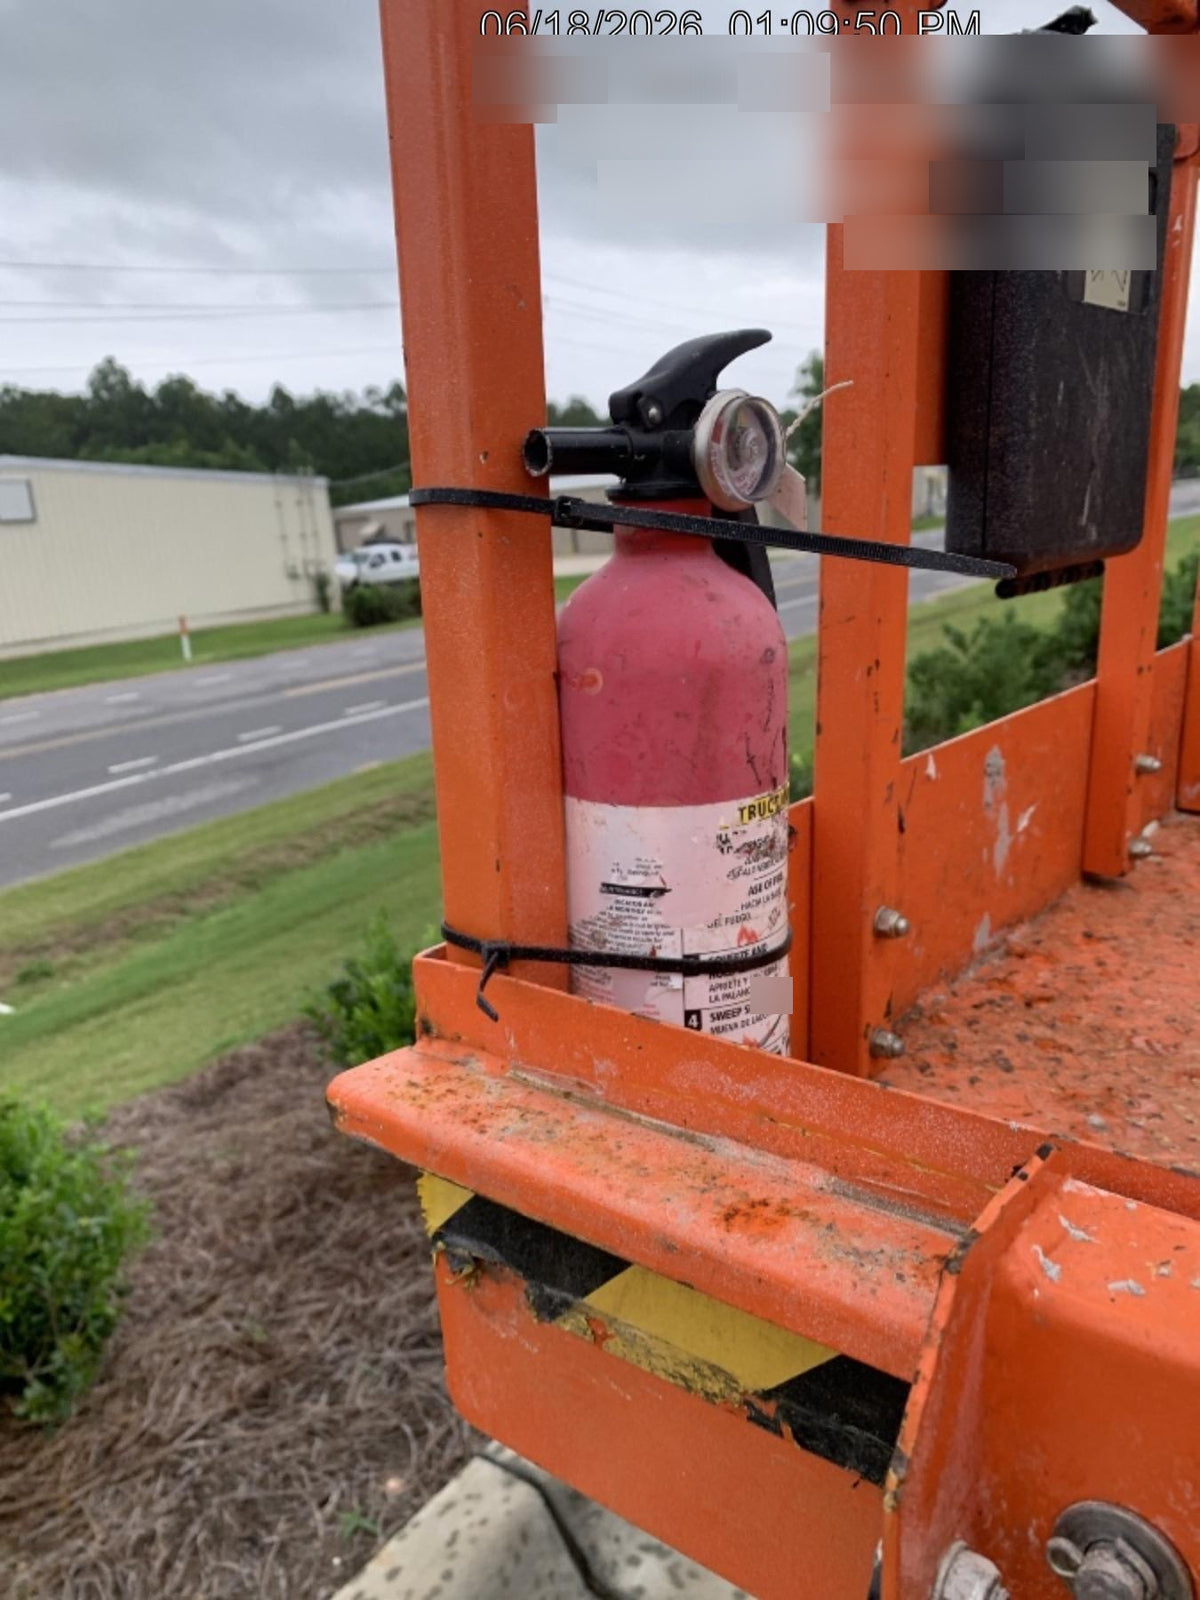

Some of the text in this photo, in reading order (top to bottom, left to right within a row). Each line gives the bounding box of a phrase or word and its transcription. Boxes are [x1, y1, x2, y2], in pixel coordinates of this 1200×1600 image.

[722, 987, 751, 1000] PALANC
[688, 1014, 699, 1028] 4
[709, 1006, 742, 1022] SWEEP
